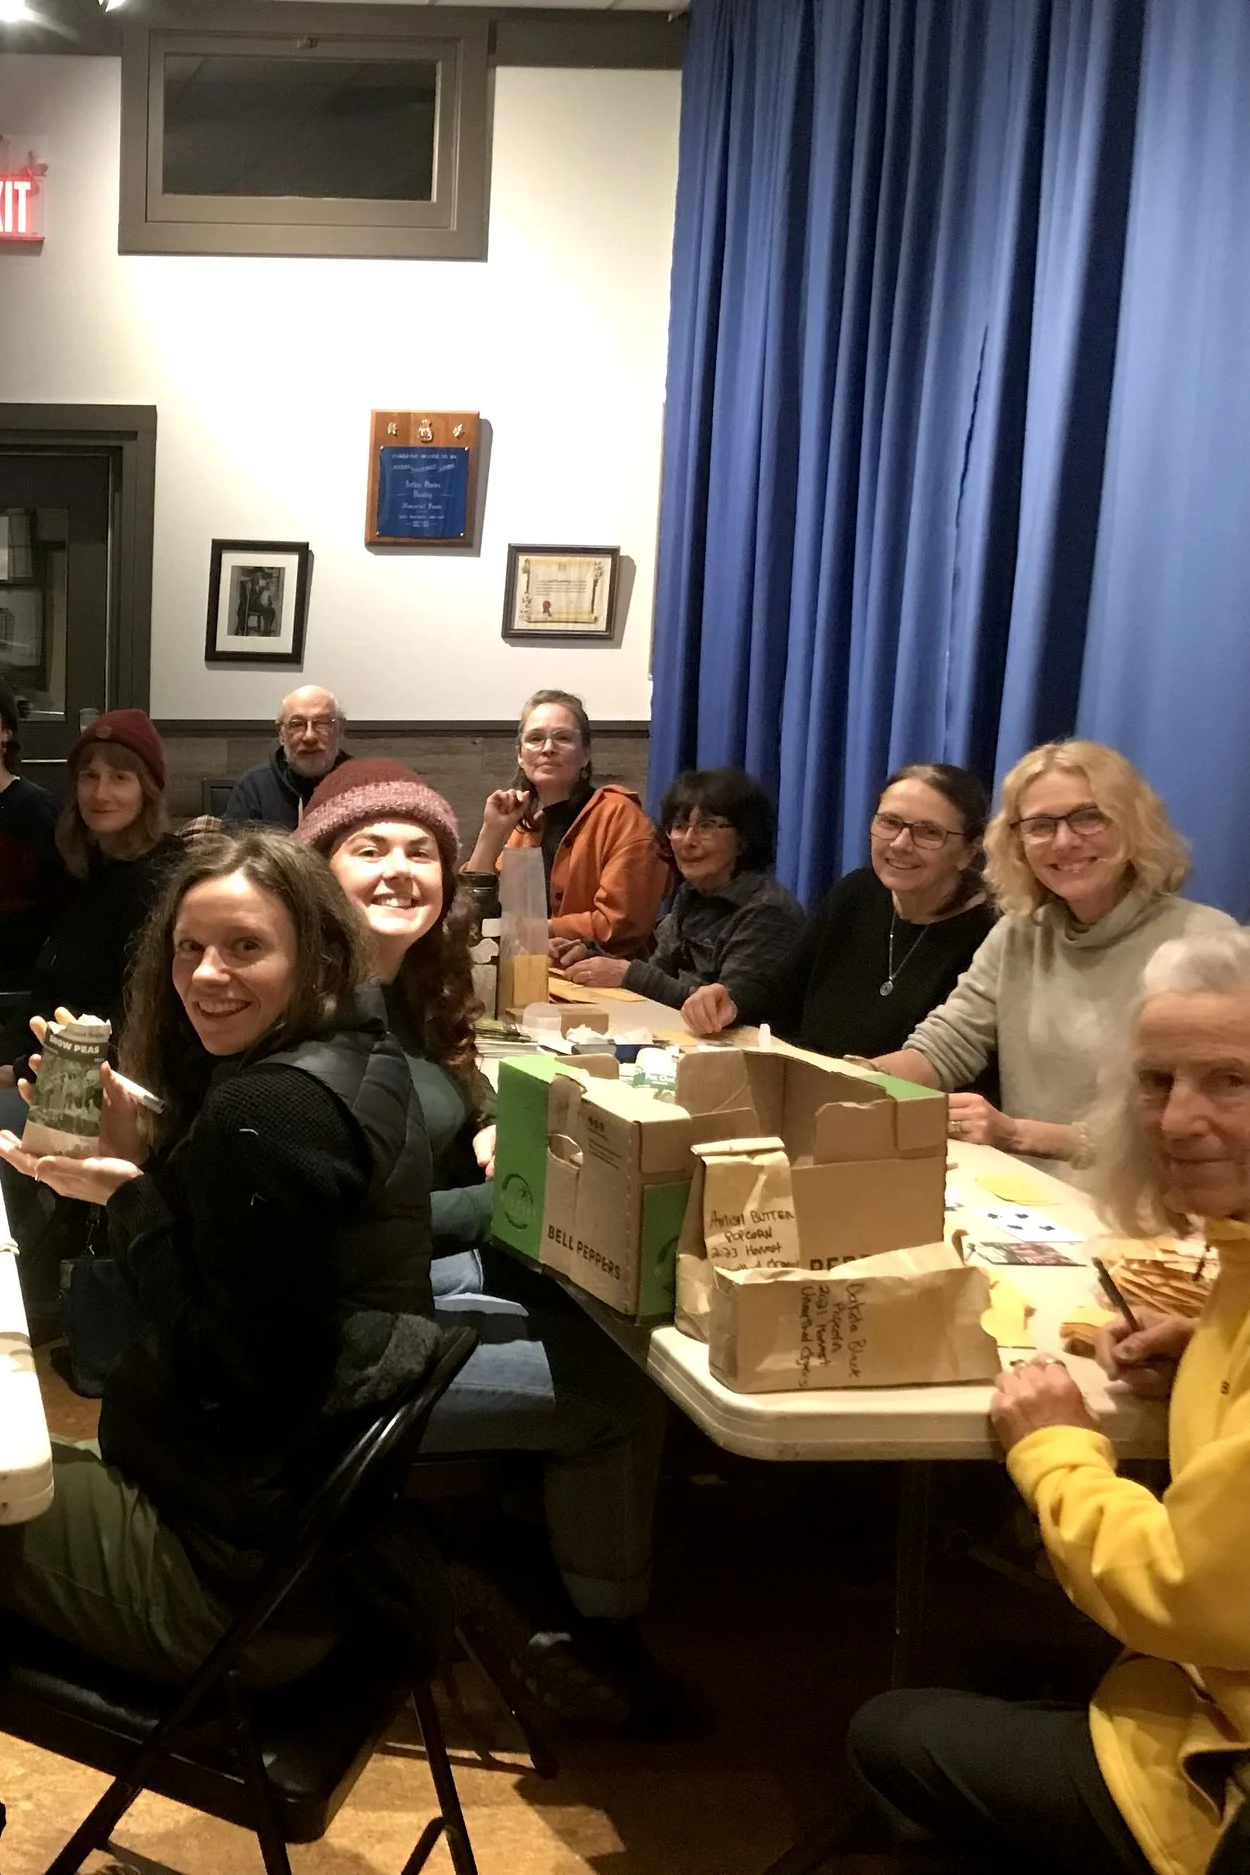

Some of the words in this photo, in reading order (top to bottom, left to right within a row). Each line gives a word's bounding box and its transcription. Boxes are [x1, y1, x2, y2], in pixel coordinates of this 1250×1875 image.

[49, 1034, 72, 1051] SNOW
[73, 1044, 100, 1054] PEAS
[548, 1225, 574, 1251] BELL
[576, 1241, 621, 1280] PEPPERS
